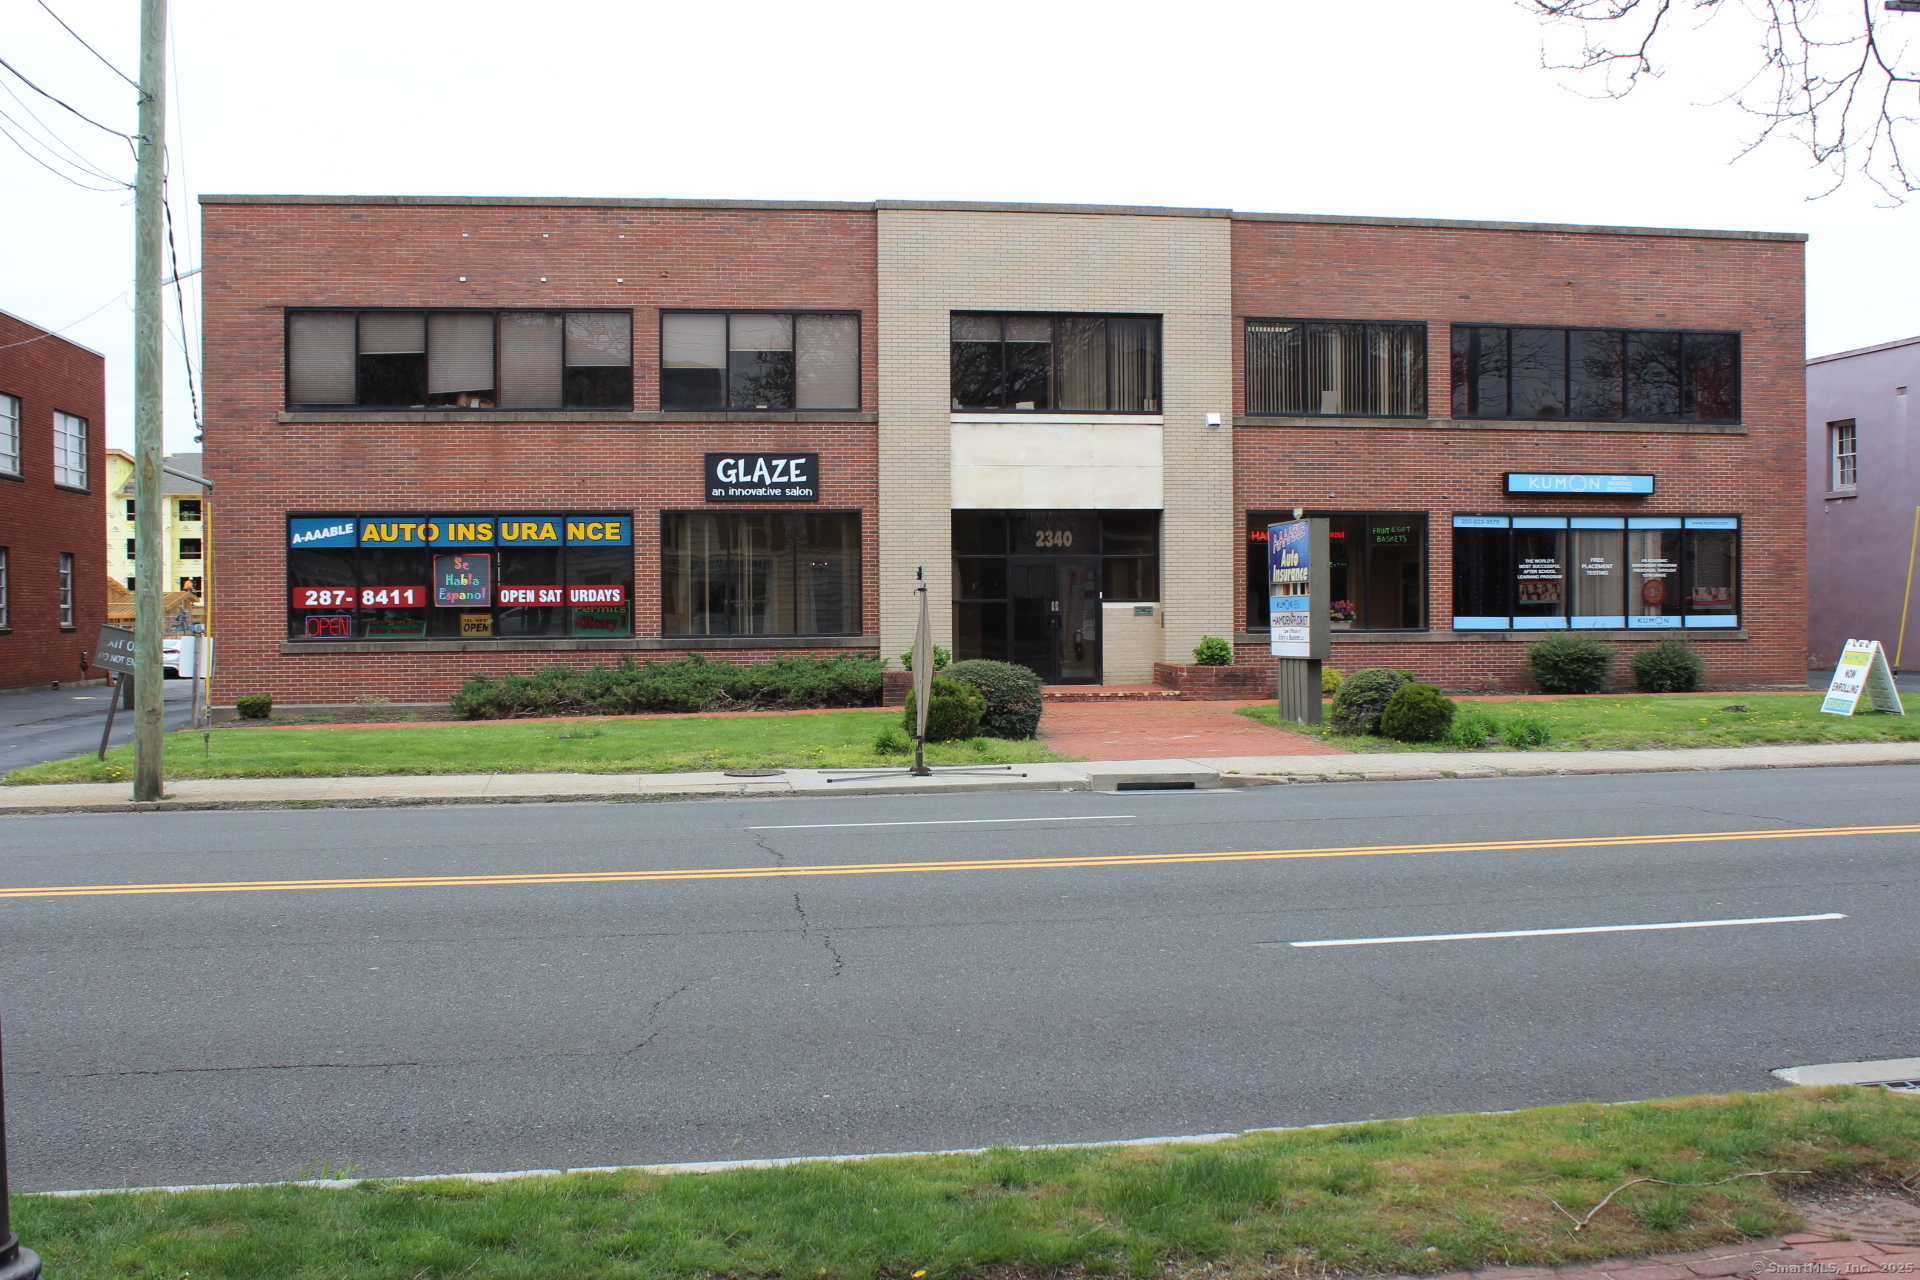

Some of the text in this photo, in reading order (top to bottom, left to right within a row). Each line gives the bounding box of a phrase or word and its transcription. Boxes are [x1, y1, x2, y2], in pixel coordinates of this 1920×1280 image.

[716, 457, 807, 486] GLAZE
[1528, 475, 1600, 492] KUMON
[711, 486, 813, 496] an innovative salon
[292, 523, 354, 544] A-AAABLE
[361, 523, 441, 542] AUTO
[1372, 527, 1390, 535] FRUIT
[1035, 530, 1073, 547] 2340
[1376, 535, 1408, 543] BASKETS
[454, 556, 470, 570] Se
[1280, 548, 1299, 567] Auto
[445, 573, 480, 586] Habla
[1272, 564, 1308, 582] Insurance
[305, 589, 414, 606] 287- 8411
[439, 587, 486, 604] Espanol
[500, 589, 535, 603] OPEN
[307, 617, 349, 637] OPEN
[463, 623, 489, 632] OPEN
[1637, 616, 1670, 625] KUMON
[110, 654, 126, 664] NOT
[1844, 669, 1858, 679] NOW
[1831, 682, 1860, 694] ENROLLING
